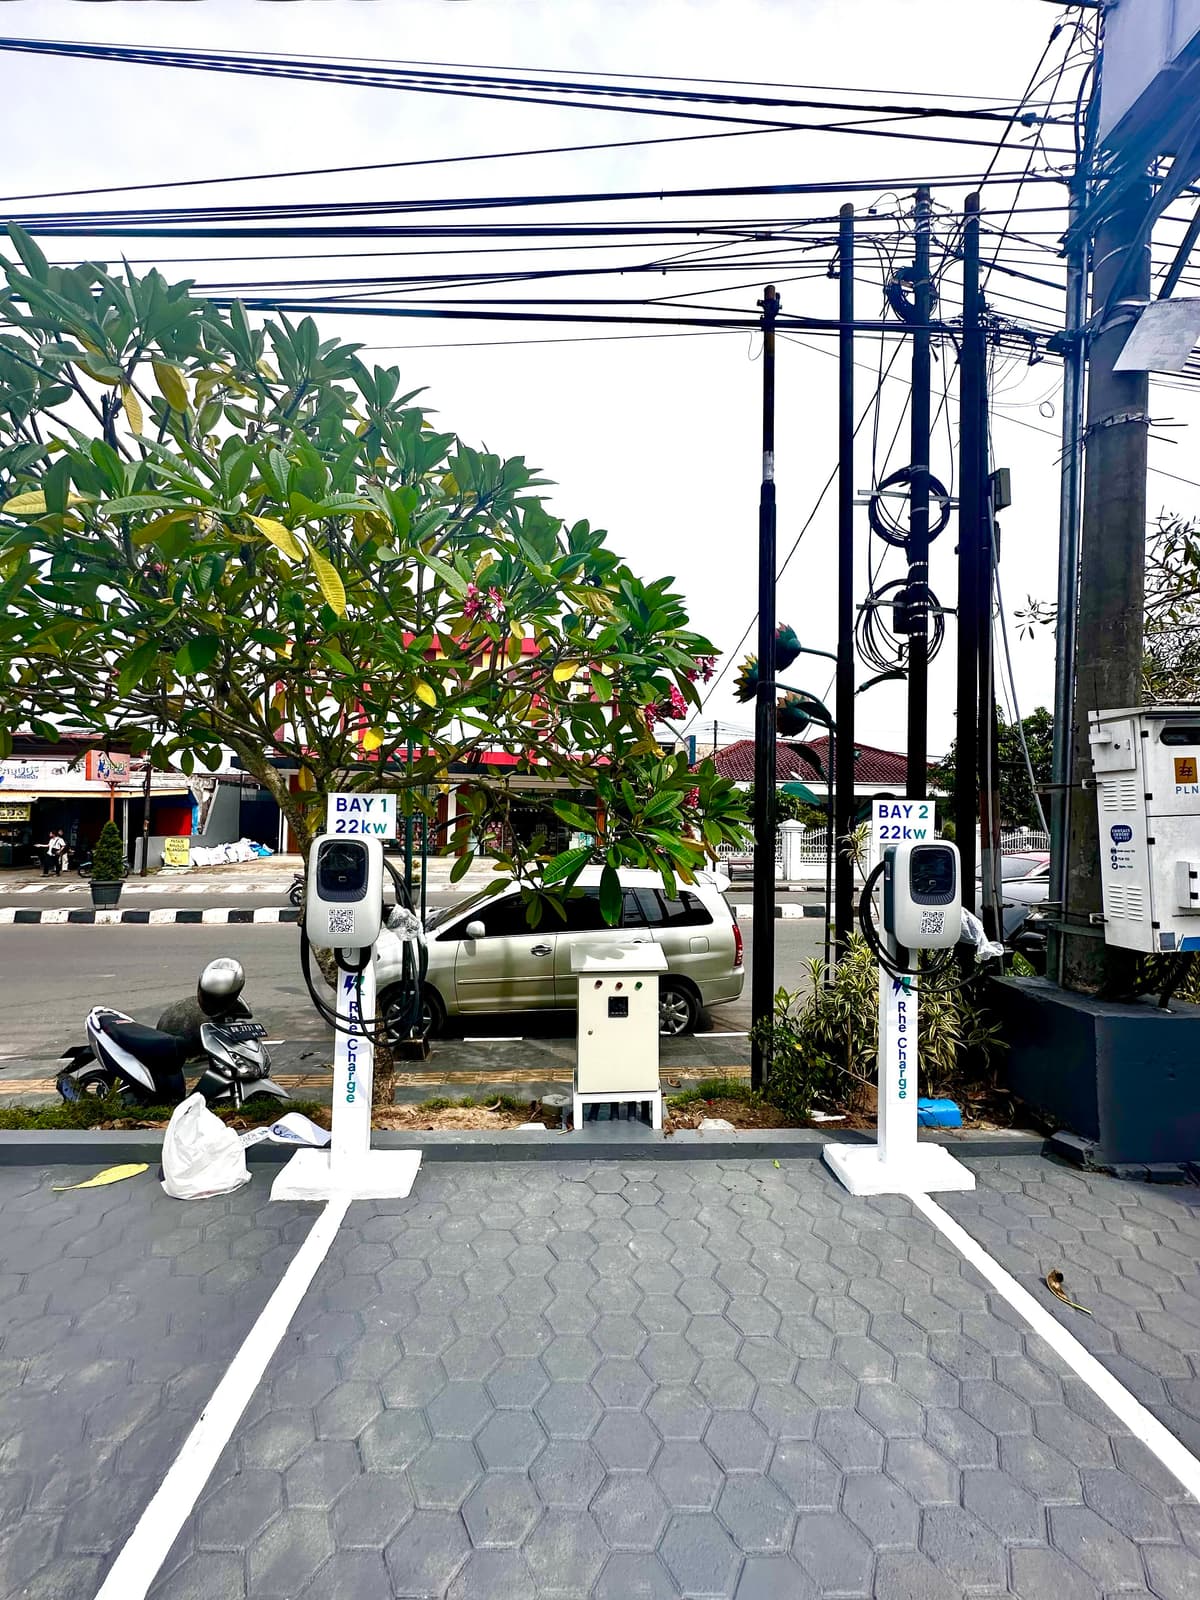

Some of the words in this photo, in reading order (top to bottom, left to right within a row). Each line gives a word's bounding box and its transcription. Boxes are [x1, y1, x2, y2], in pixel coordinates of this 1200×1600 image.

[1175, 785, 1199, 795] PLN
[336, 797, 374, 813] BAY
[380, 798, 387, 813] 1
[879, 804, 913, 819] BAY
[918, 804, 929, 819] 2
[335, 818, 387, 834] 22kw
[879, 825, 927, 840] 22kw
[348, 1000, 359, 1035] Rhe
[897, 1001, 907, 1033] Rhe
[345, 1038, 359, 1103] Charge
[897, 1037, 908, 1100] Charge
